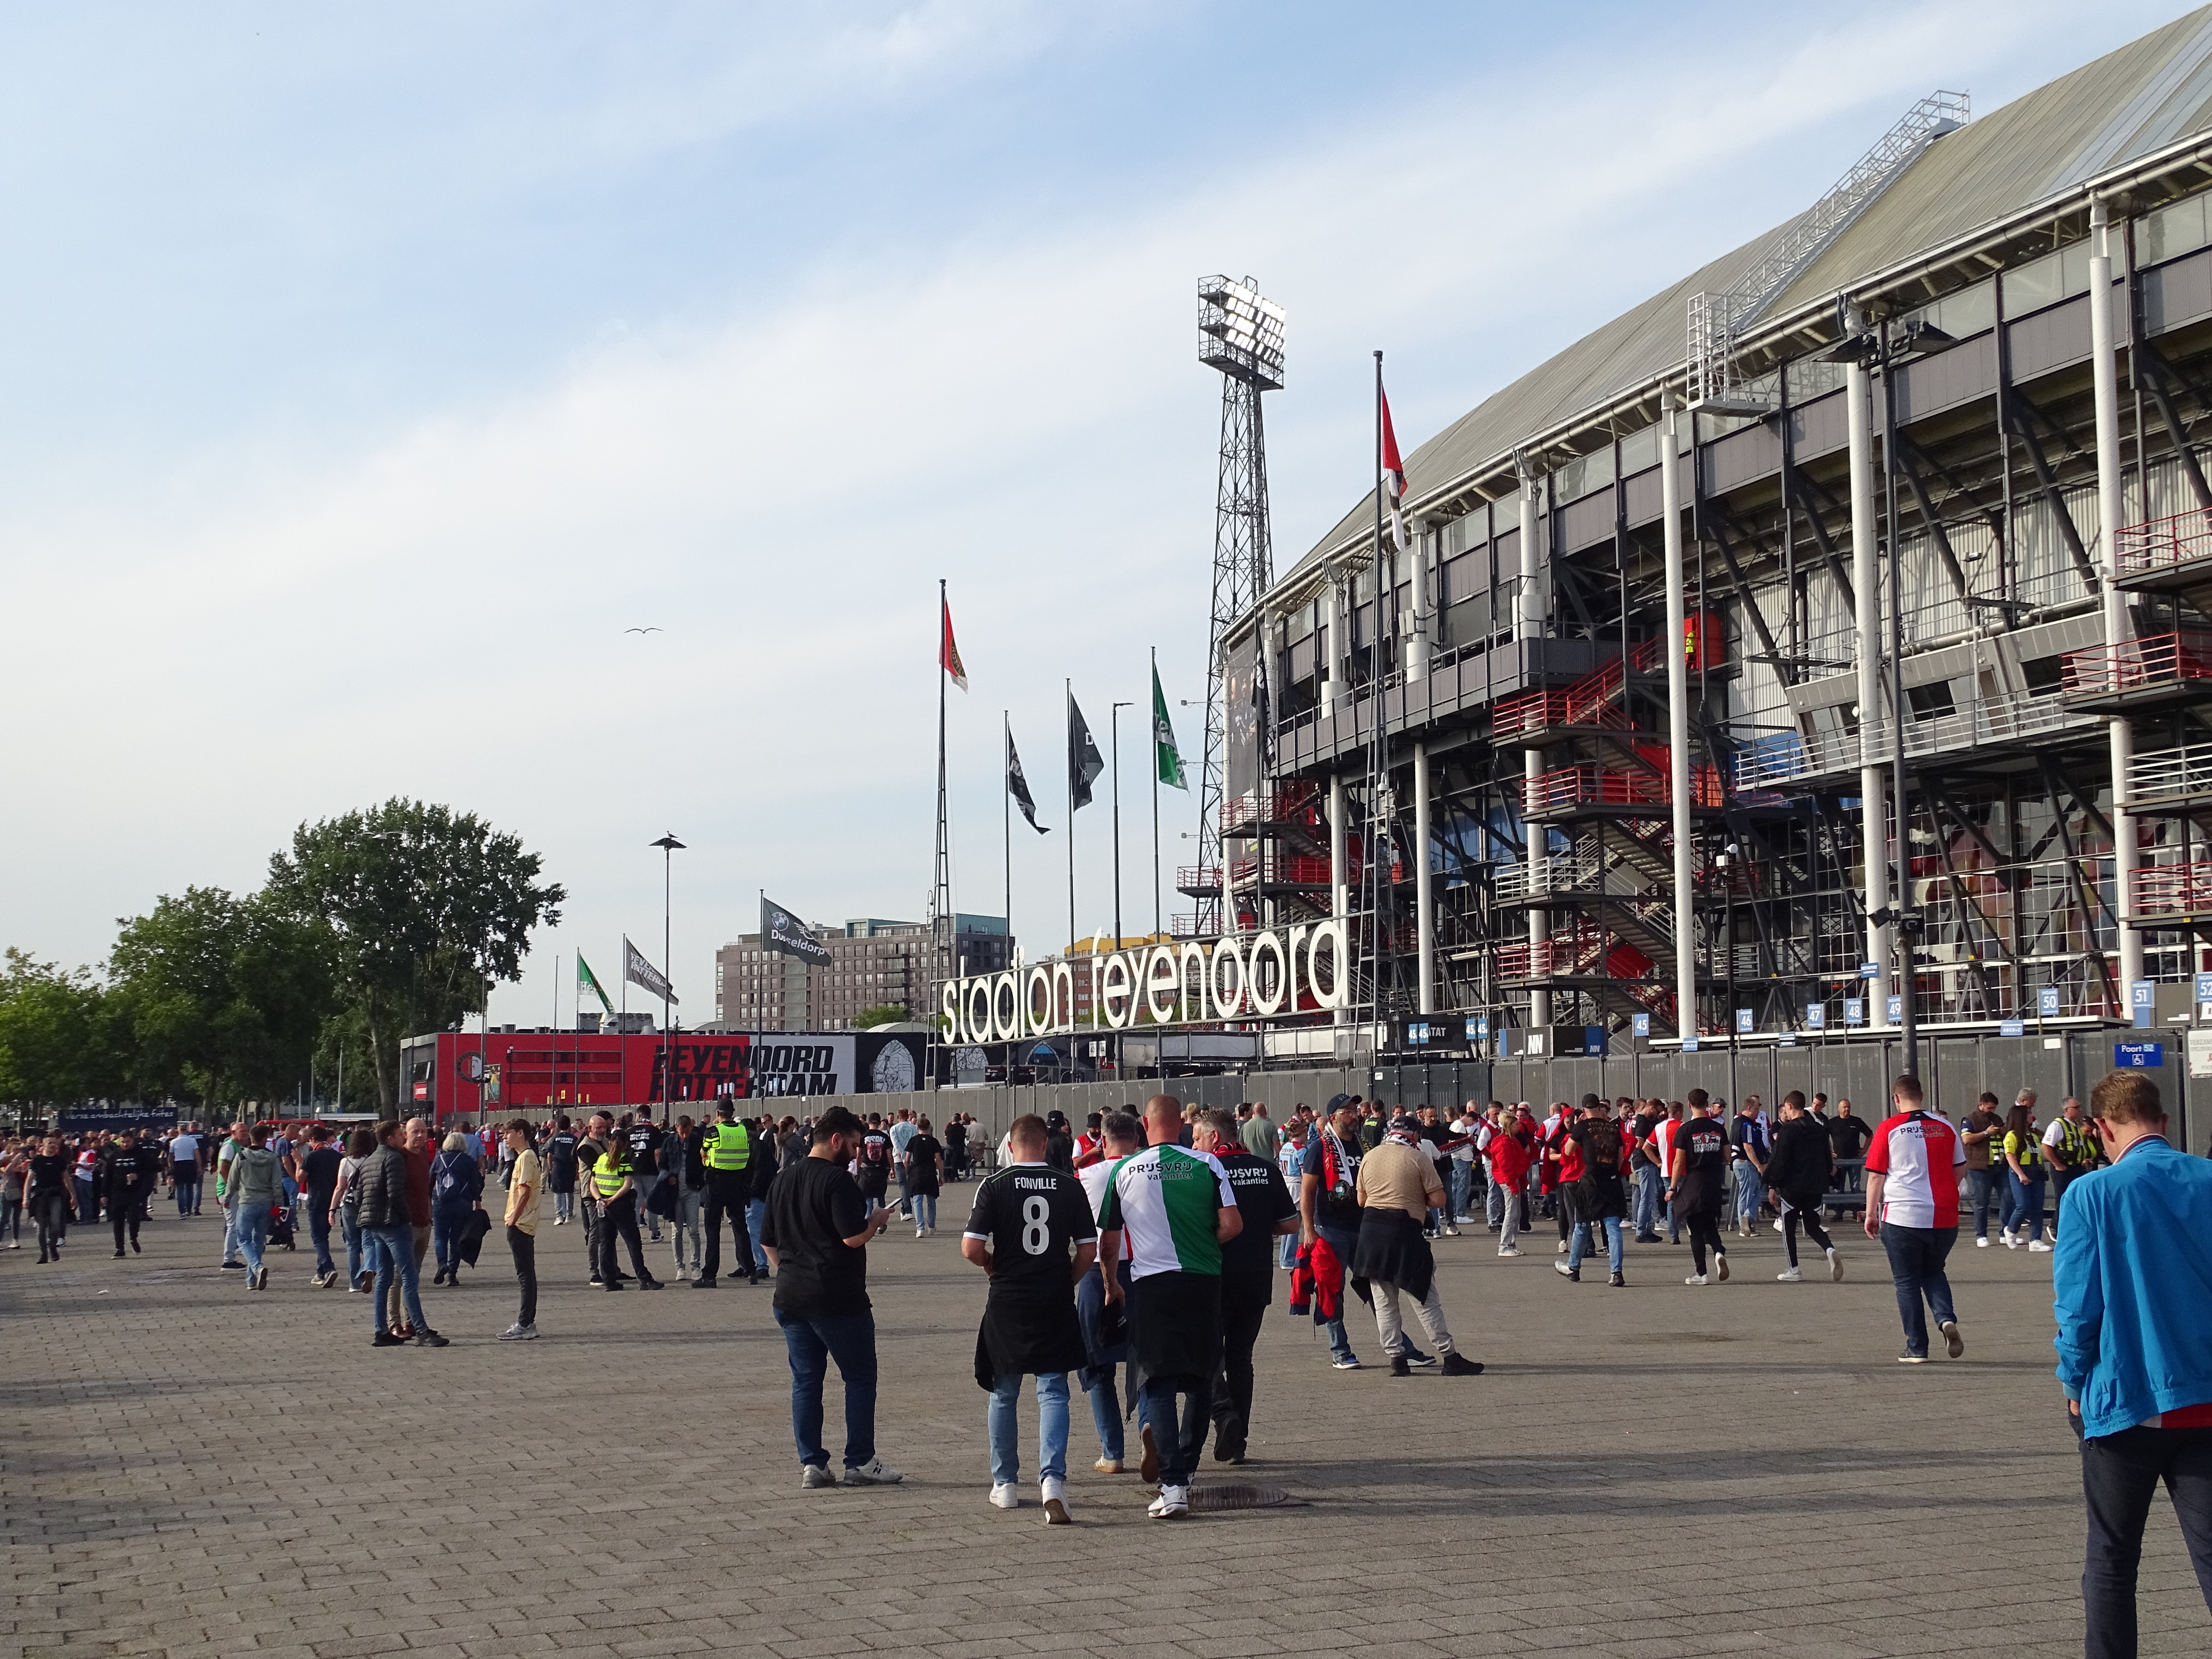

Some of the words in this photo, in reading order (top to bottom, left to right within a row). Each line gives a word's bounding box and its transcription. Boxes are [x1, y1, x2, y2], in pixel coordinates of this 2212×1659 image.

[943, 945, 1074, 1045] stadion
[1091, 884, 1349, 1030] feyenoord
[2135, 989, 2147, 1002] 51
[2043, 995, 2056, 1009] 50
[1848, 1006, 1860, 1018] 48
[1889, 1003, 1901, 1015] 49
[1741, 1015, 1752, 1026] 46
[1809, 1010, 1820, 1022] 47
[1466, 1025, 1476, 1035] 45
[1636, 1020, 1647, 1030] 45
[1528, 1034, 1543, 1055] NN
[652, 1045, 834, 1073] FEYENOORD
[647, 1073, 838, 1101] ROTTERDAM
[1129, 1161, 1192, 1176] PRIJSVRIJ
[1225, 1168, 1268, 1179] RIJSVRIJ
[1147, 1173, 1193, 1181] vakanties
[1232, 1176, 1269, 1186] vakanties
[1015, 1177, 1057, 1190] FONVILLE
[1022, 1195, 1049, 1255] 8
